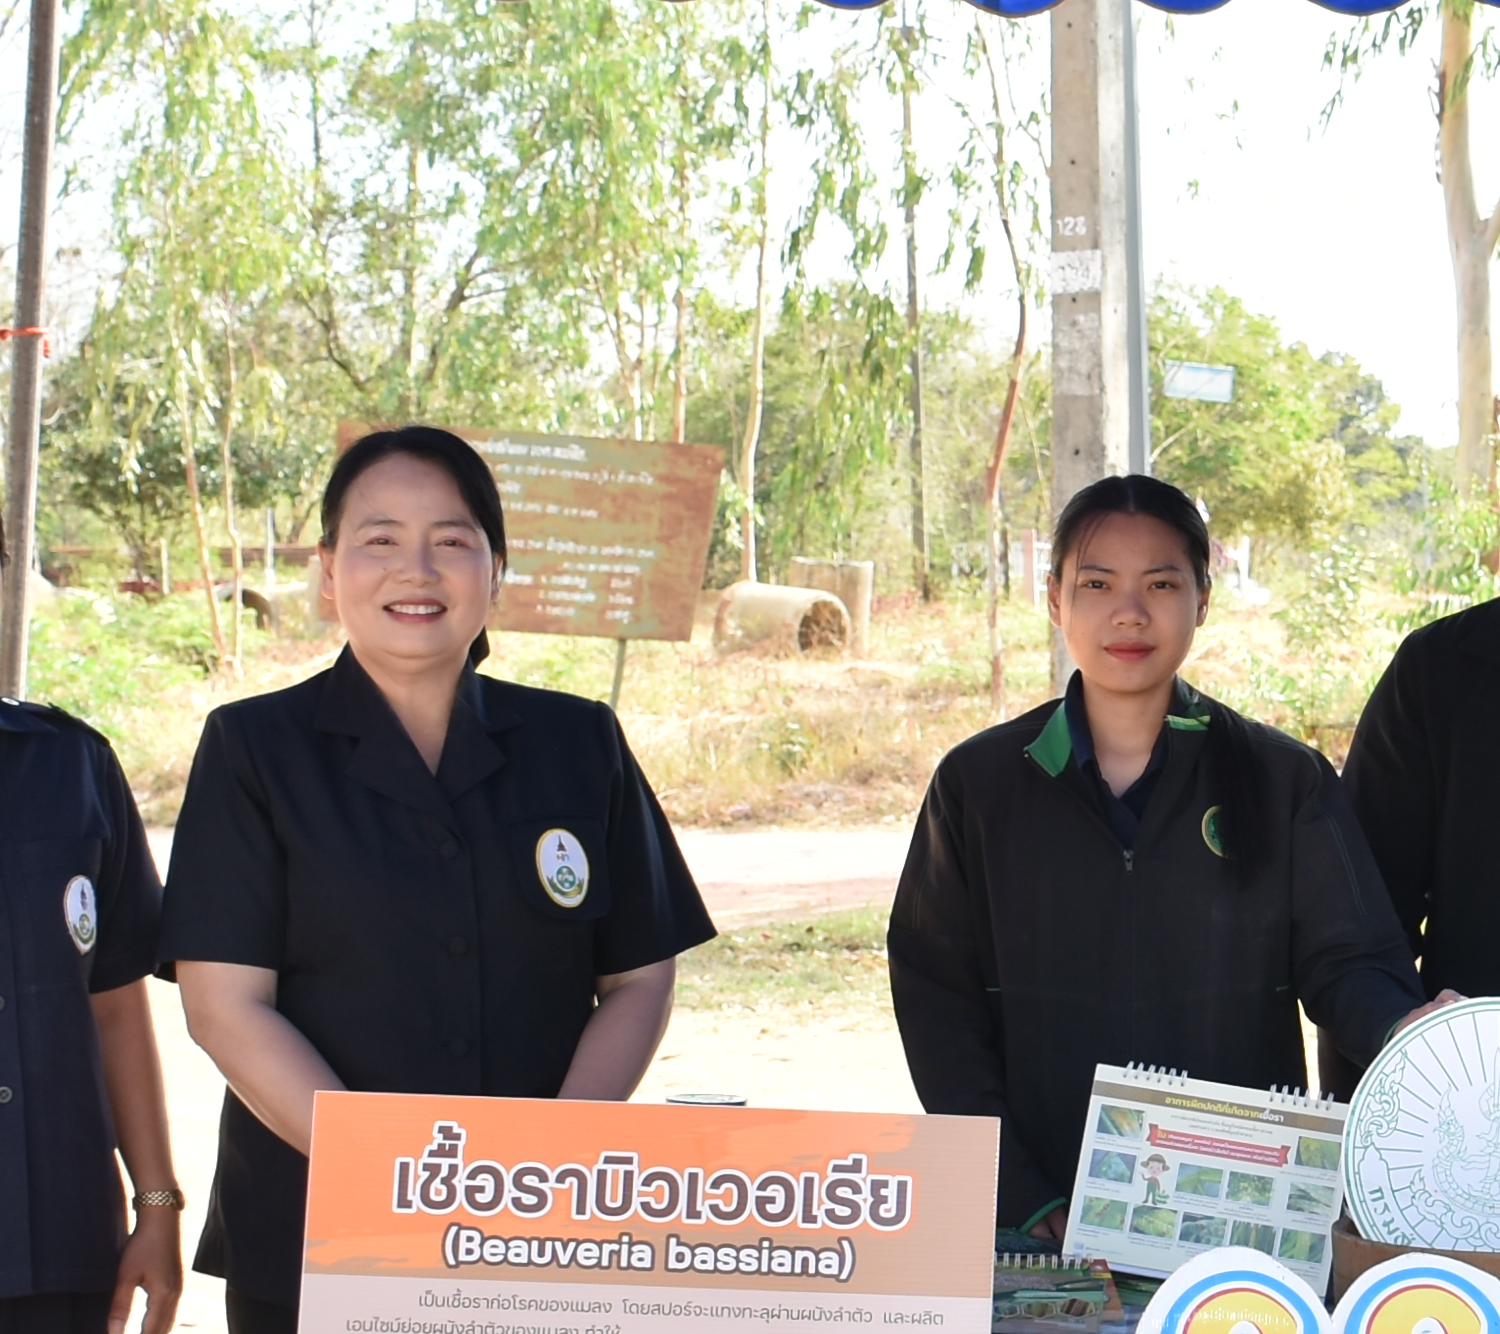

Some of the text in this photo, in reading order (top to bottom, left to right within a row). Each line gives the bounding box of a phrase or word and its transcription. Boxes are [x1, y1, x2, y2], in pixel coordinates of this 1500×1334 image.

[396, 1123, 911, 1227] เชื้อราบิวเวอเรีย
[444, 1227, 854, 1280] (Beauveria bassiana)
[884, 1310, 943, 1326] และผลิต
